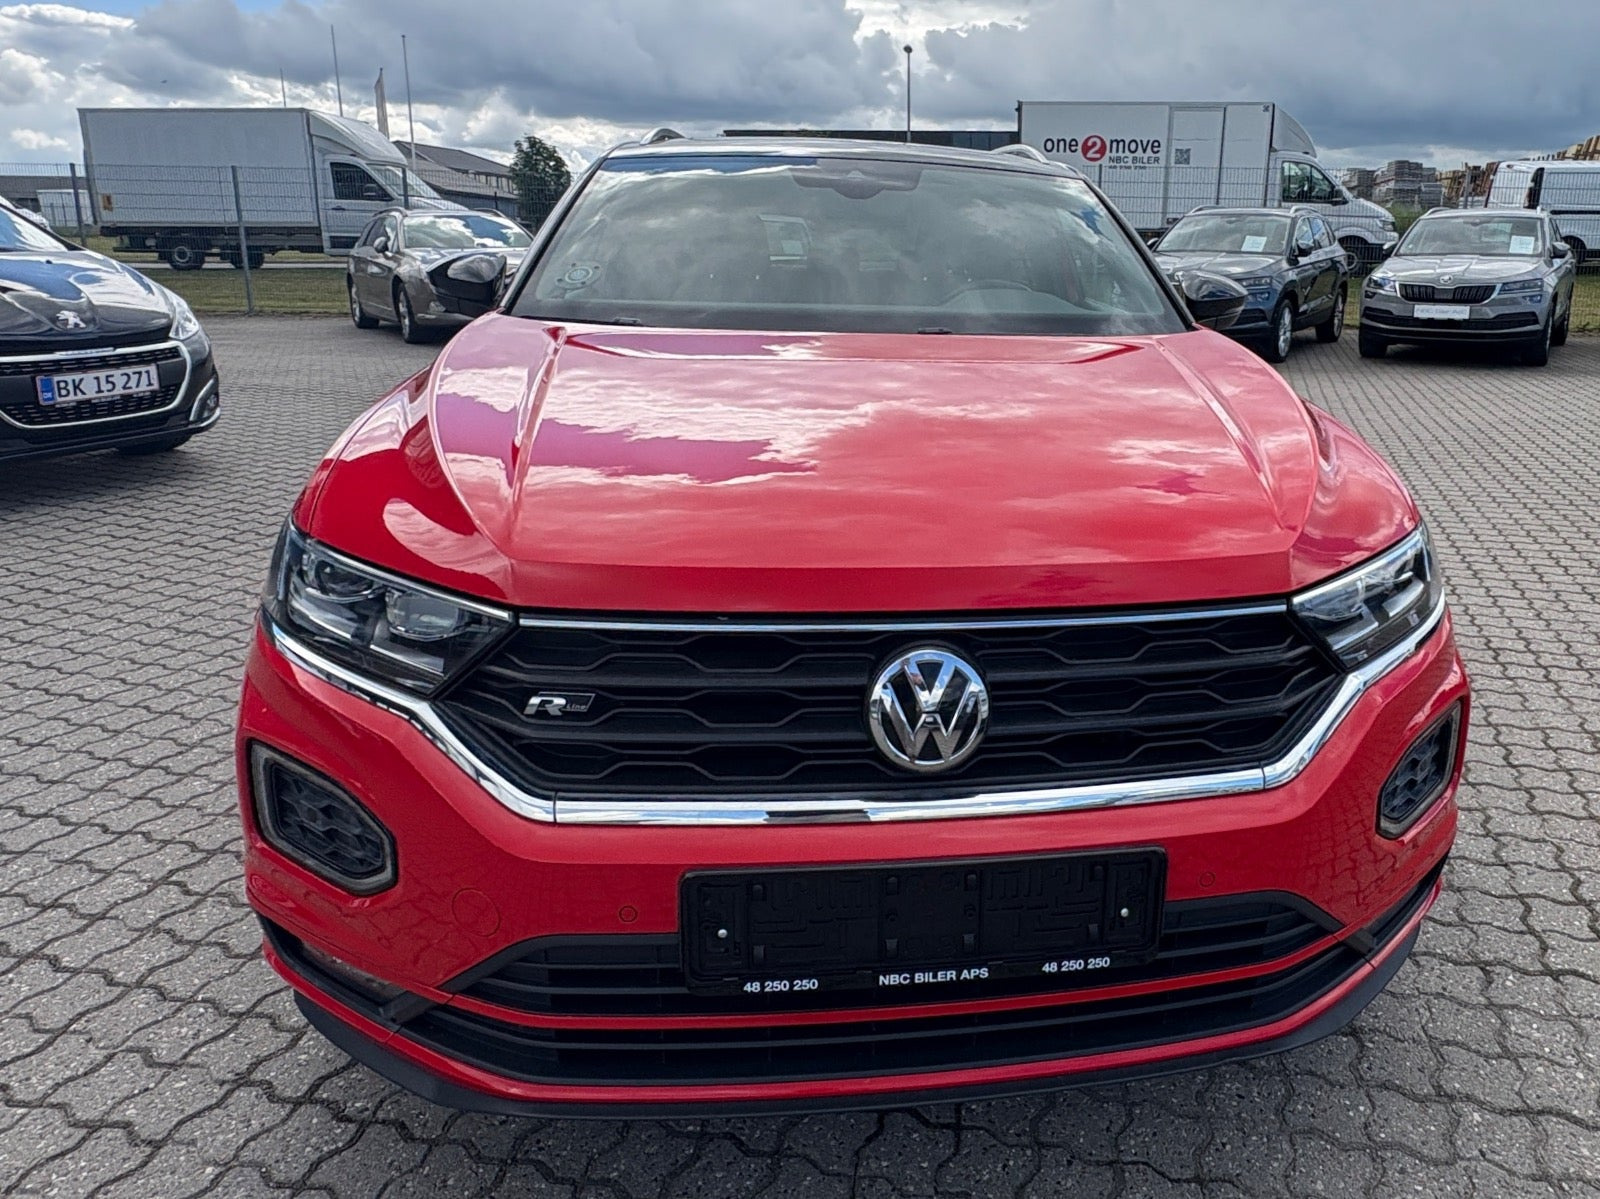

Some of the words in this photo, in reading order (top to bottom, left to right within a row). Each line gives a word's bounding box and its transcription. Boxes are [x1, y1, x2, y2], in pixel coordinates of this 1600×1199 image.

[1108, 156, 1129, 165] NBC
[1131, 155, 1160, 165] BILER
[55, 377, 87, 398] BK
[93, 374, 116, 394] 15
[120, 370, 154, 390] 271
[523, 695, 567, 716] R
[1041, 961, 1058, 973] 48
[1061, 959, 1085, 972] 250
[1087, 956, 1111, 969] 250
[743, 981, 761, 993] 48
[764, 980, 790, 992] 250
[793, 978, 819, 990] 250
[878, 972, 910, 986] NBC
[914, 970, 957, 984] BILER
[960, 967, 989, 981] APS
